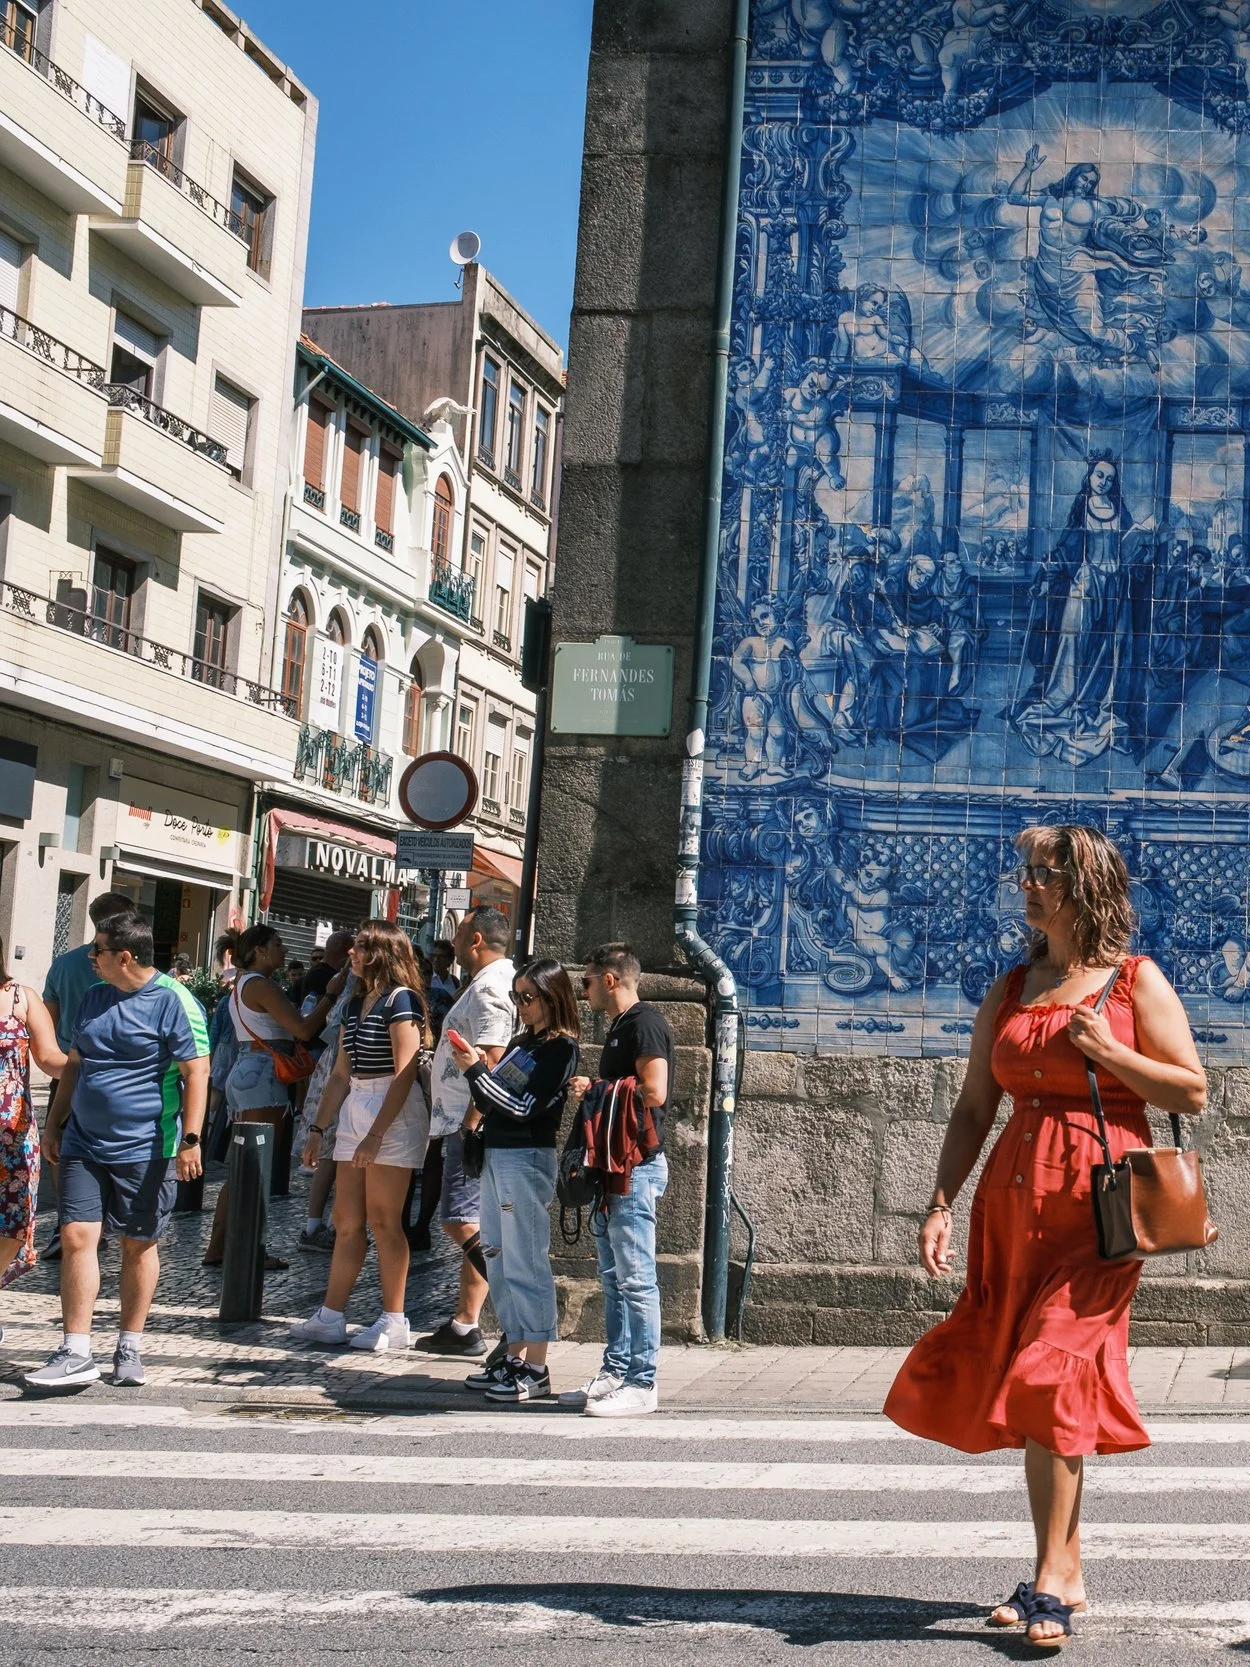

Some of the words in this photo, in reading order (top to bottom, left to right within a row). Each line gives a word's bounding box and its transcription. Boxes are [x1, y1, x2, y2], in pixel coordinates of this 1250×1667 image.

[598, 652, 616, 661] RUA
[620, 652, 632, 661] DE
[573, 668, 655, 683] FERNANDES
[320, 679, 336, 697] 2-T2
[590, 684, 636, 702] TOMÁS
[164, 809, 188, 831] Doce
[191, 816, 213, 838] Porto
[400, 836, 417, 847] EXCETO
[440, 837, 471, 849] AUTORIZADOS
[316, 843, 408, 887] NOVALMA
